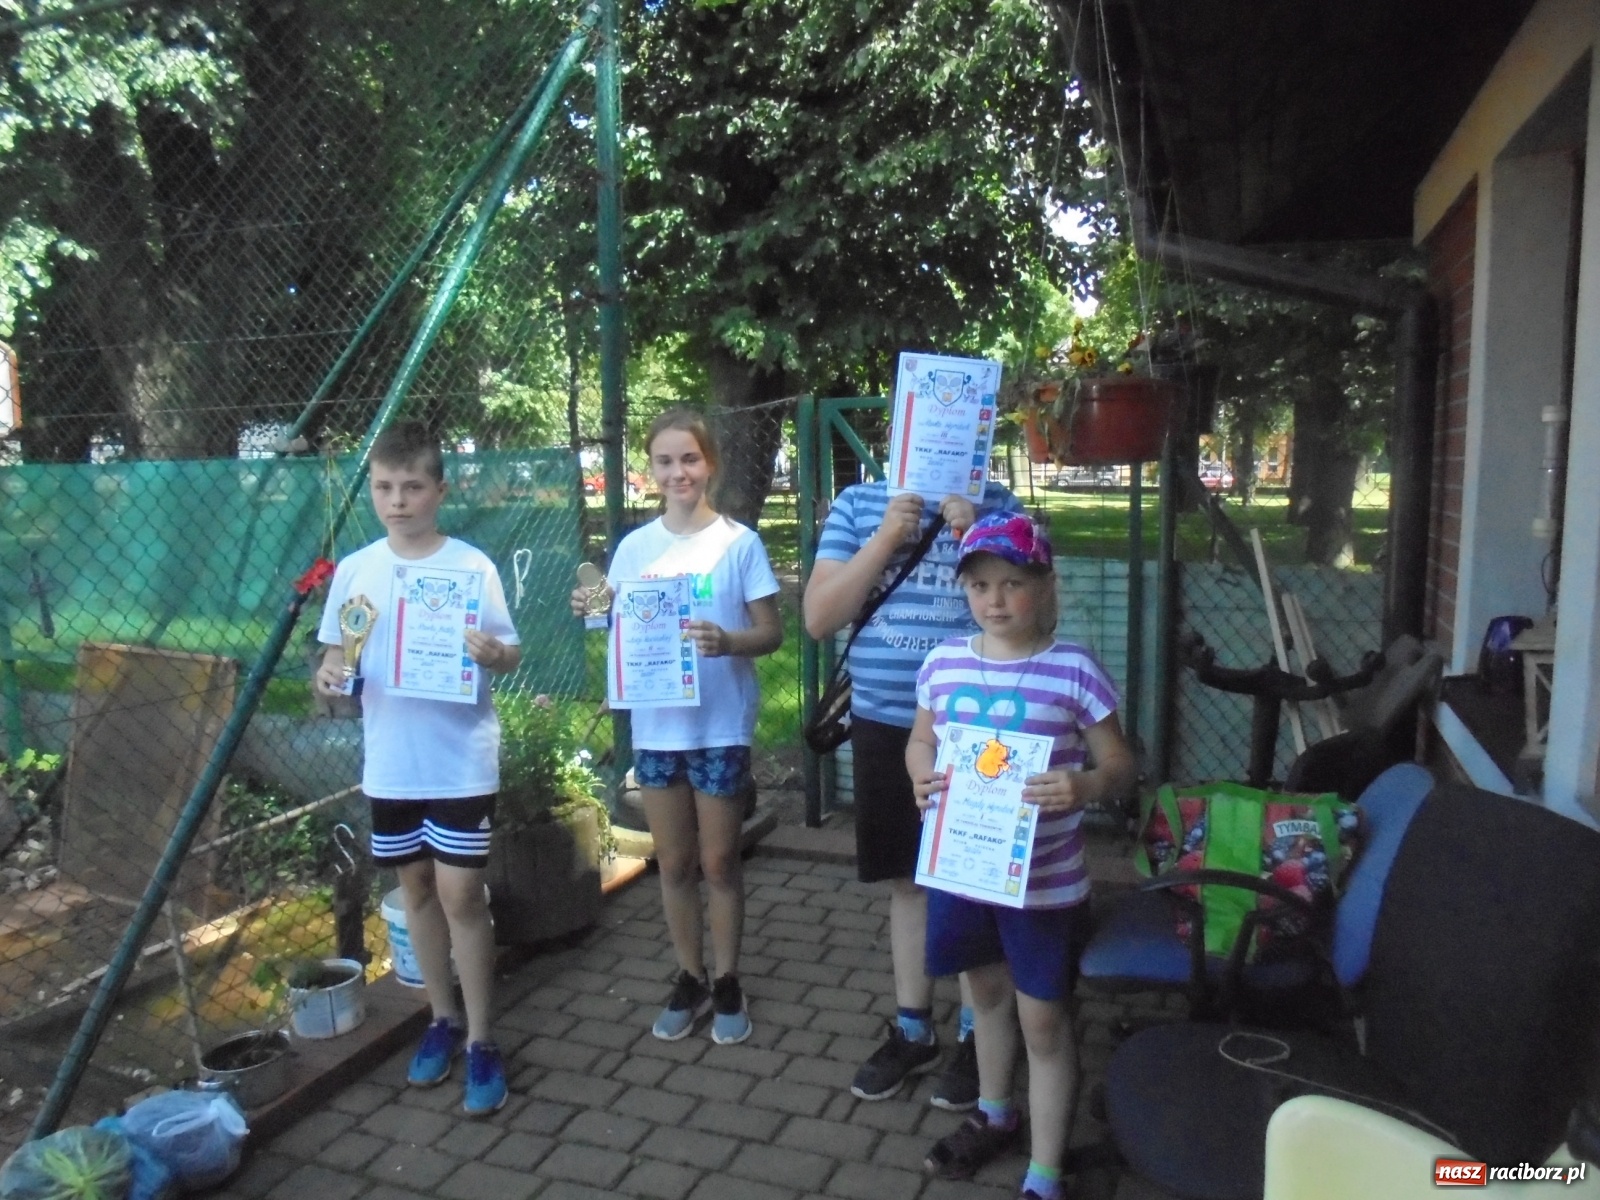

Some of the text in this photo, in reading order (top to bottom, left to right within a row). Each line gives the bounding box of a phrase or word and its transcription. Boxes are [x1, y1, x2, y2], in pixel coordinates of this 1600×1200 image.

[928, 403, 966, 418] Dyplom
[915, 446, 933, 454] TKKF
[932, 597, 965, 609] JUNIOR
[888, 608, 961, 622] CHAMPIONSHIP
[632, 620, 667, 634] Dyplom
[966, 779, 1008, 797] Dyplom
[949, 827, 967, 837] TKKF
